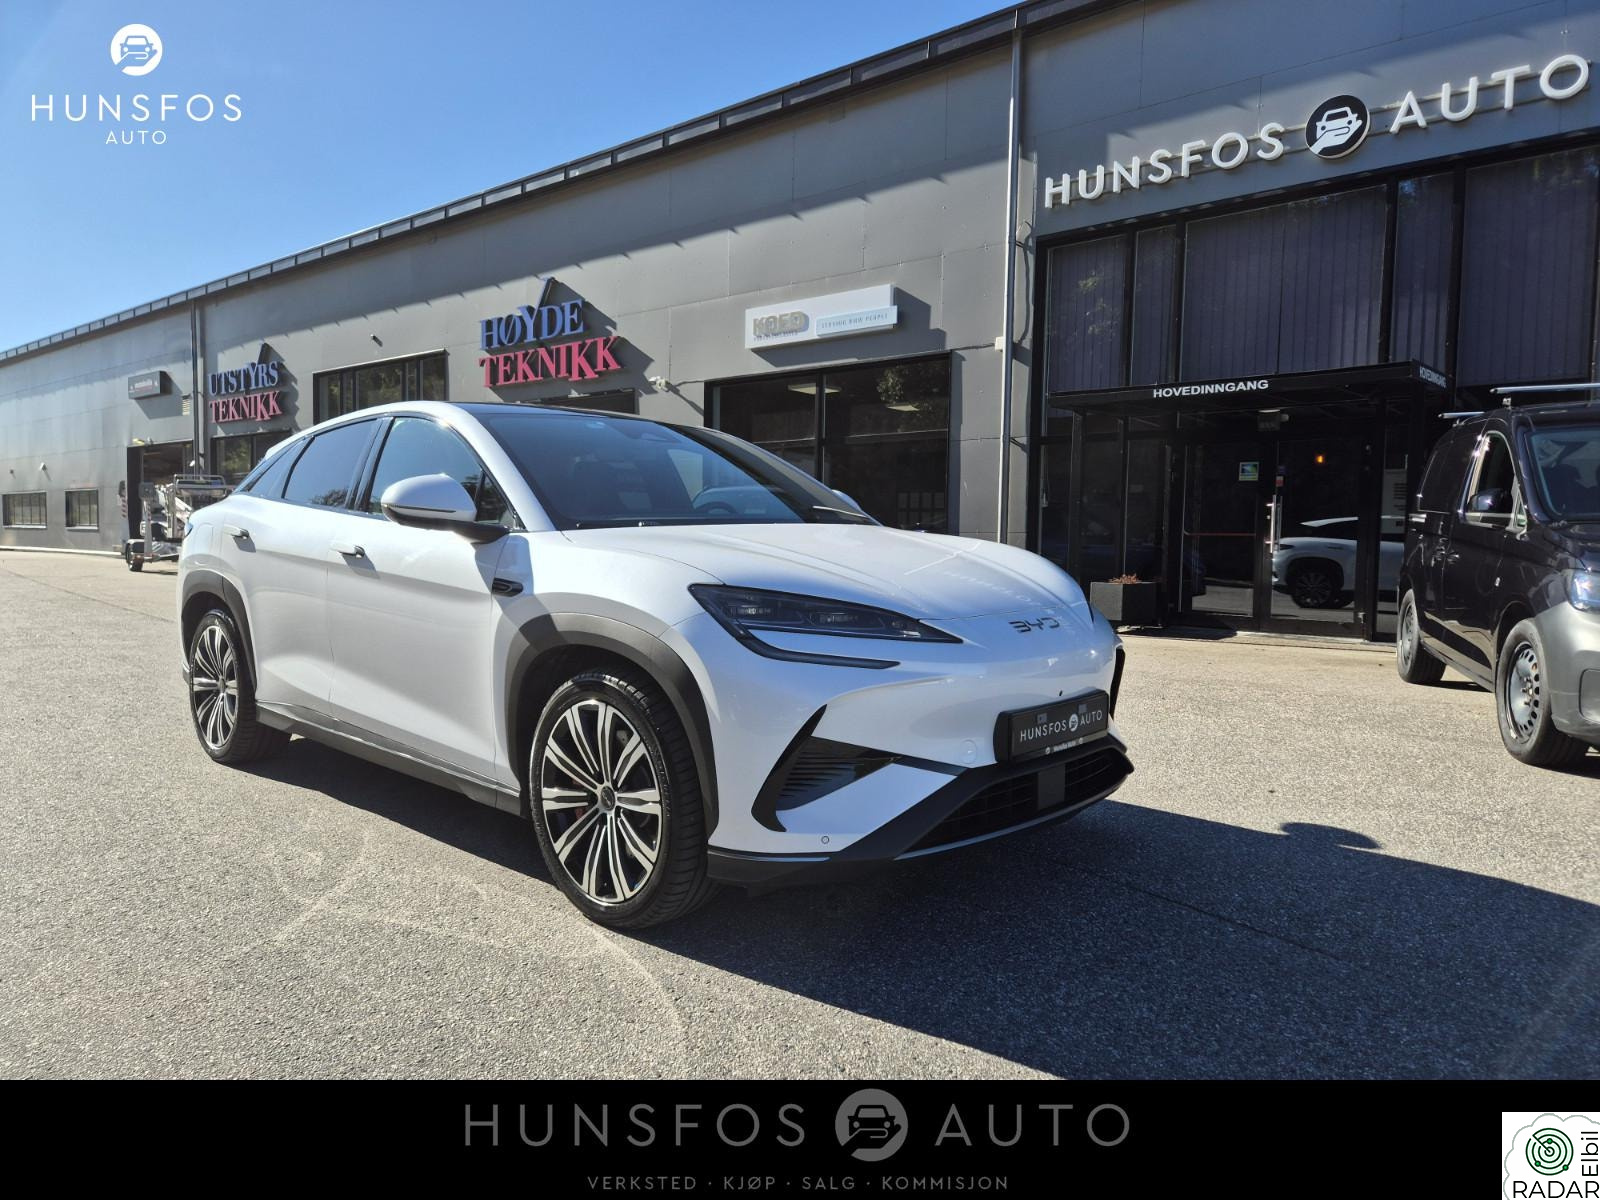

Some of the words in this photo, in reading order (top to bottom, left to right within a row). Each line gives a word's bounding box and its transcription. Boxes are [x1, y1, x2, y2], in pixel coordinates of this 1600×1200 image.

[1044, 122, 1286, 208] HUNSFOS
[1389, 53, 1590, 135] AUTO
[480, 297, 584, 351] HØYDE
[207, 361, 279, 396] UTSTYRS
[478, 335, 622, 388] TEKNIKK
[1153, 380, 1269, 398] HOVEDINNGANG
[208, 390, 283, 424] TEKNIKK
[1009, 617, 1060, 633] BYD
[1020, 720, 1067, 743] HUNSFOS
[1080, 710, 1103, 726] AUTO
